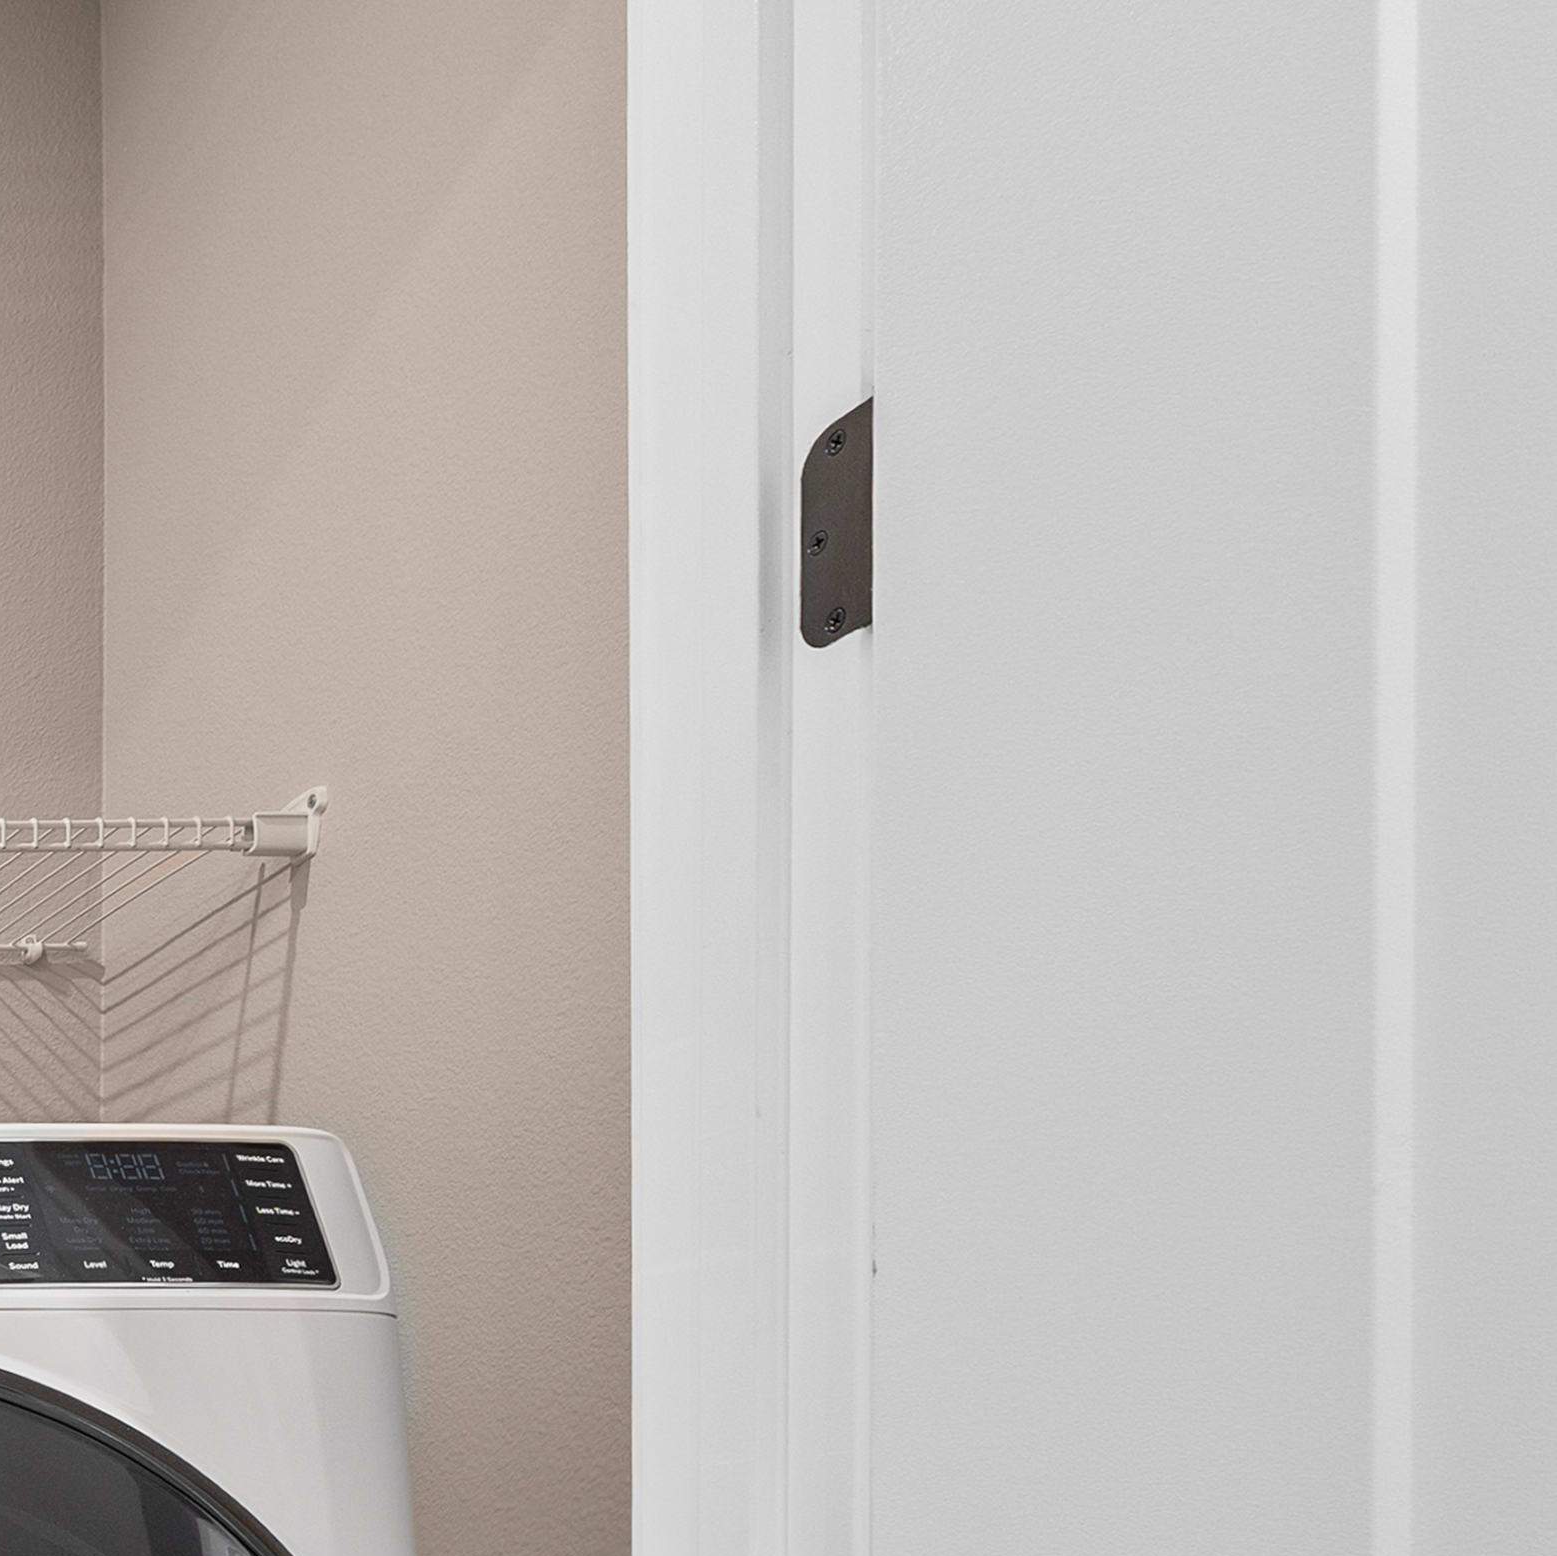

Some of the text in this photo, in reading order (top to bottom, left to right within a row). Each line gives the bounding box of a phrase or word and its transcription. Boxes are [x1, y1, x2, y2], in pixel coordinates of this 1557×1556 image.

[236, 1154, 285, 1163] Wrinkle Care
[2, 1176, 24, 1184] Alert
[245, 1179, 266, 1188] More
[266, 1180, 286, 1189] Time
[12, 1203, 30, 1212] Dry
[255, 1206, 274, 1215] Less
[275, 1207, 294, 1216] Time
[1, 1232, 28, 1241] Small
[274, 1235, 302, 1245] ecoDry
[5, 1242, 29, 1250] Load
[8, 1262, 39, 1270] Sound
[83, 1260, 107, 1269] Level
[149, 1260, 174, 1269] Temp
[216, 1260, 240, 1269] Time
[285, 1258, 307, 1268] Light
